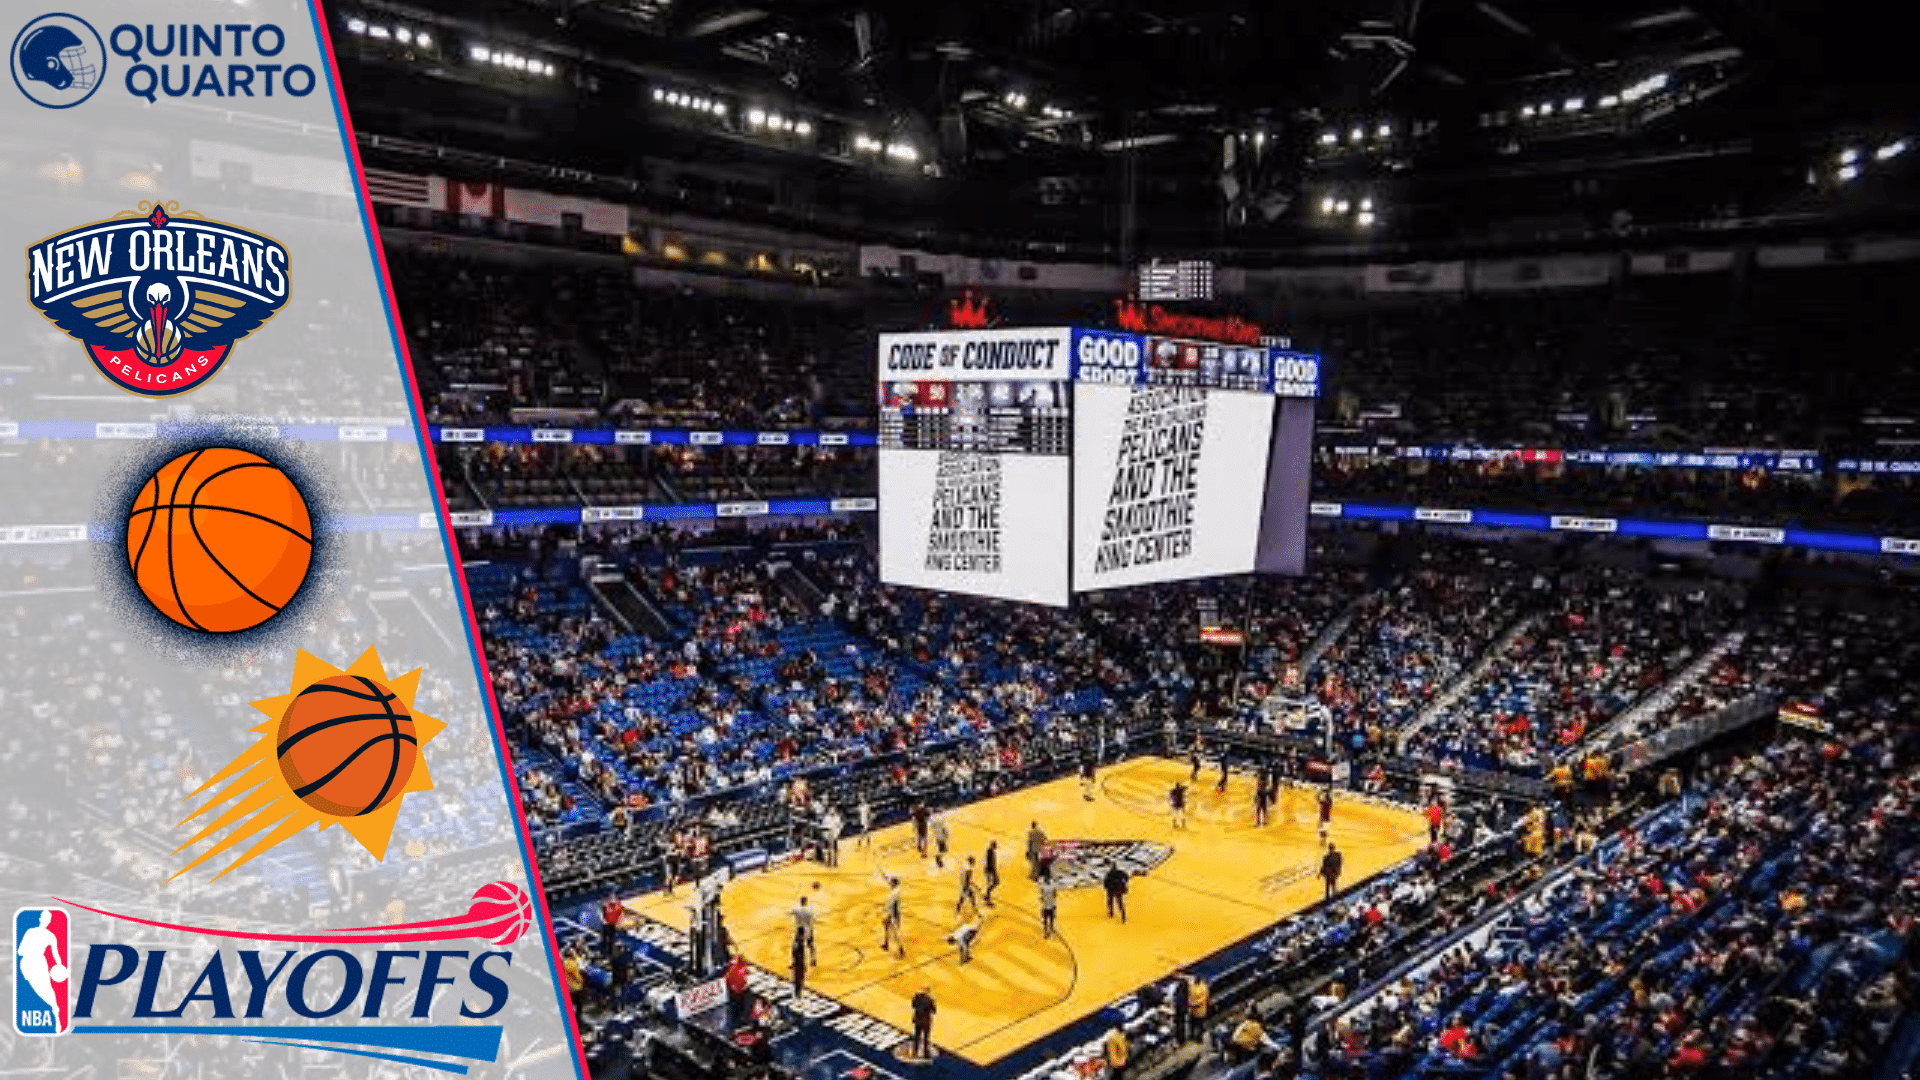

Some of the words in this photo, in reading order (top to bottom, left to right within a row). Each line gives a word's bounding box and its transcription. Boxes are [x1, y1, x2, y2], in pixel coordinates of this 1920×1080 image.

[888, 342, 936, 370] CODE
[939, 344, 961, 367] OF
[962, 338, 1060, 370] CONDUCT
[1078, 335, 1140, 367] GOOD
[1275, 356, 1317, 380] GOOD
[1117, 419, 1204, 467] PELICANS
[1107, 461, 1156, 506] AND
[1160, 451, 1200, 497] THE
[931, 507, 964, 530] AND
[968, 504, 1000, 529] THE
[1101, 491, 1197, 541] SMOOTHIE
[1134, 527, 1192, 566] CENTER
